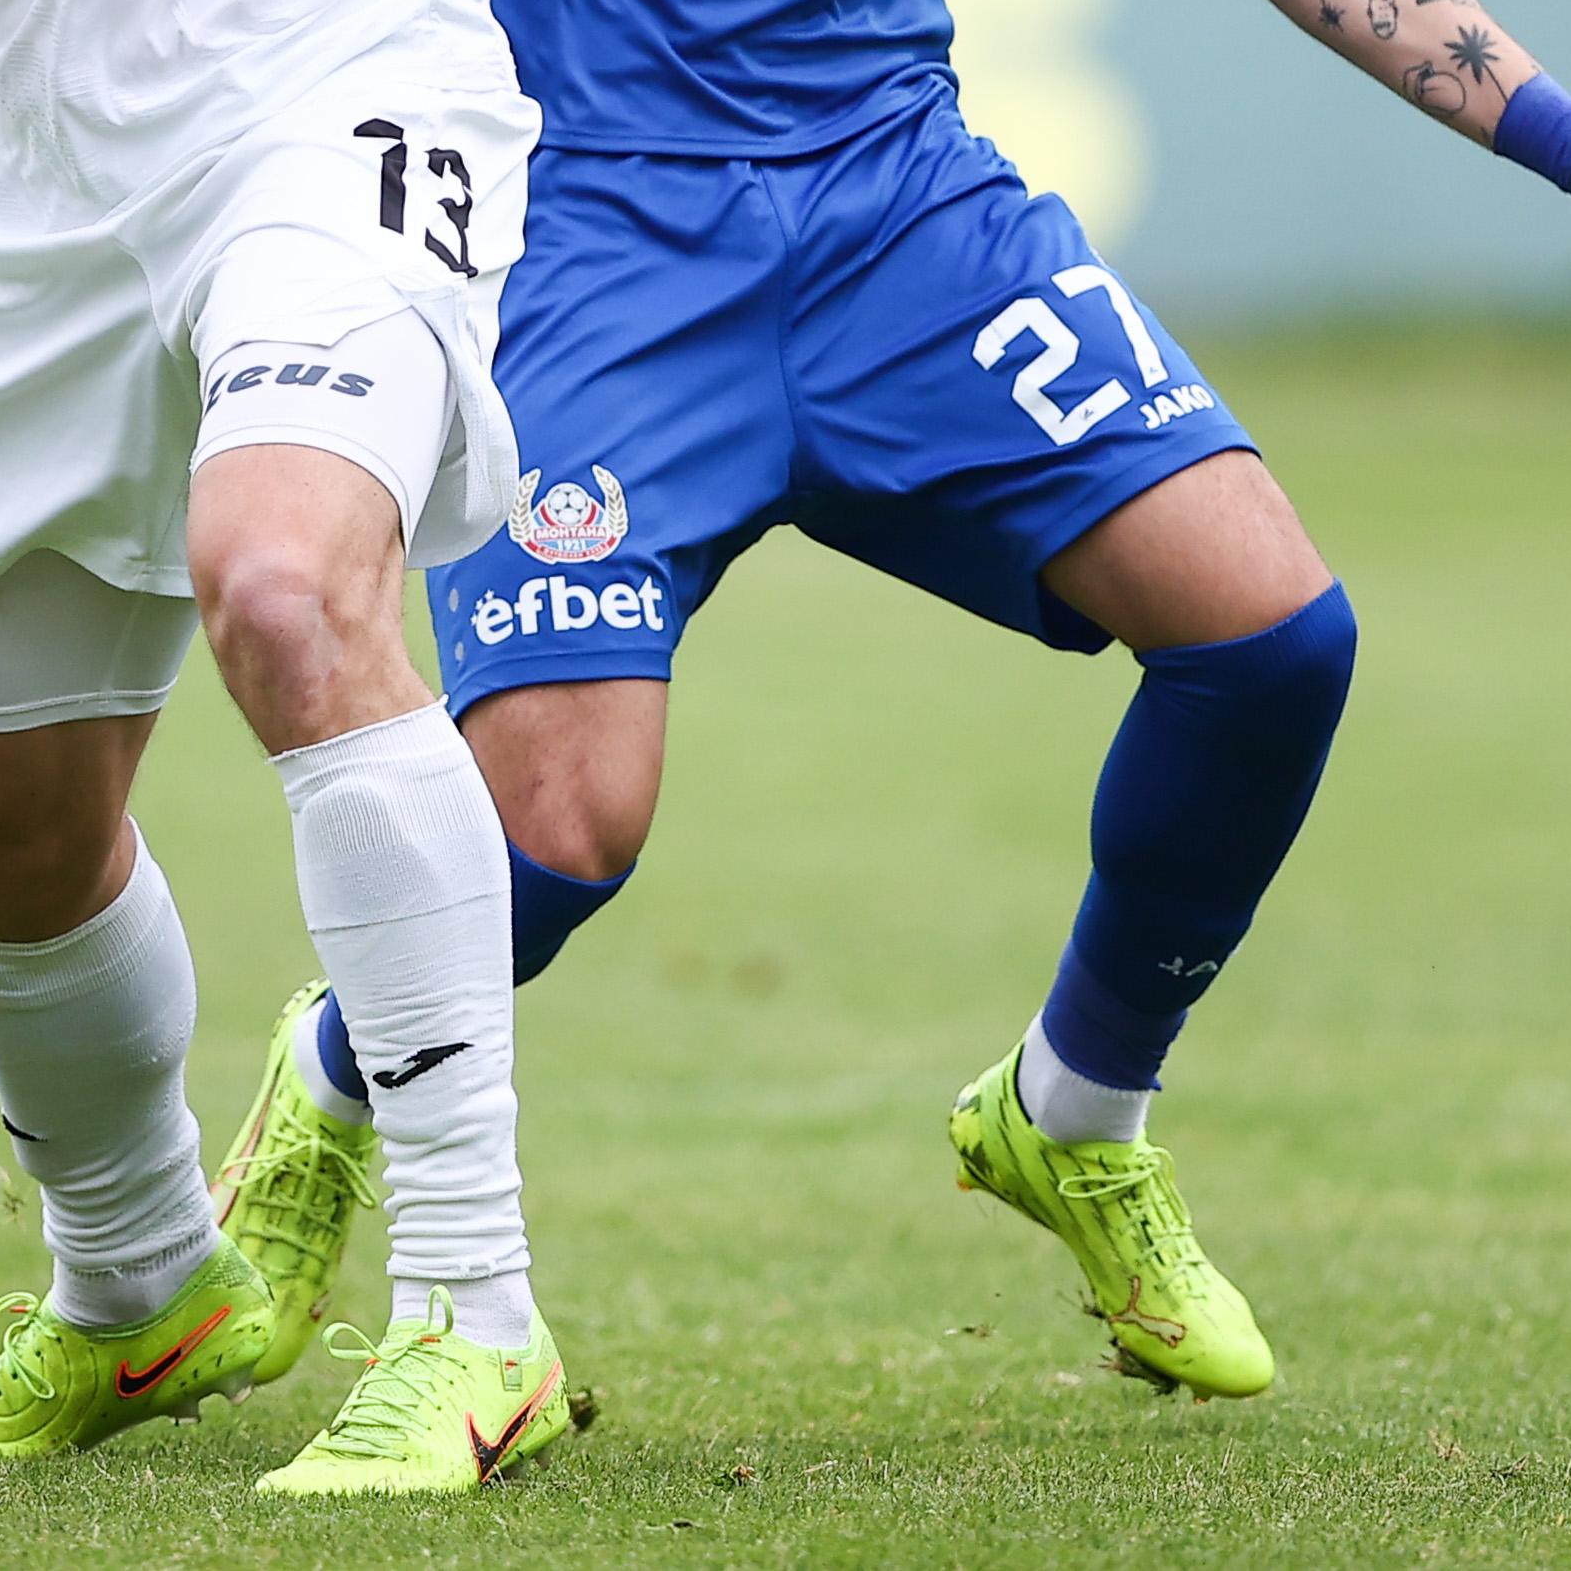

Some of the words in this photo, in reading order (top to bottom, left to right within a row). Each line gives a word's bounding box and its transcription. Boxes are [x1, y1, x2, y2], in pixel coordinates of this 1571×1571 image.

[353, 118, 478, 279] 13
[972, 263, 1170, 447] 27
[1139, 384, 1215, 431] JAKO
[475, 575, 664, 645] efbet
